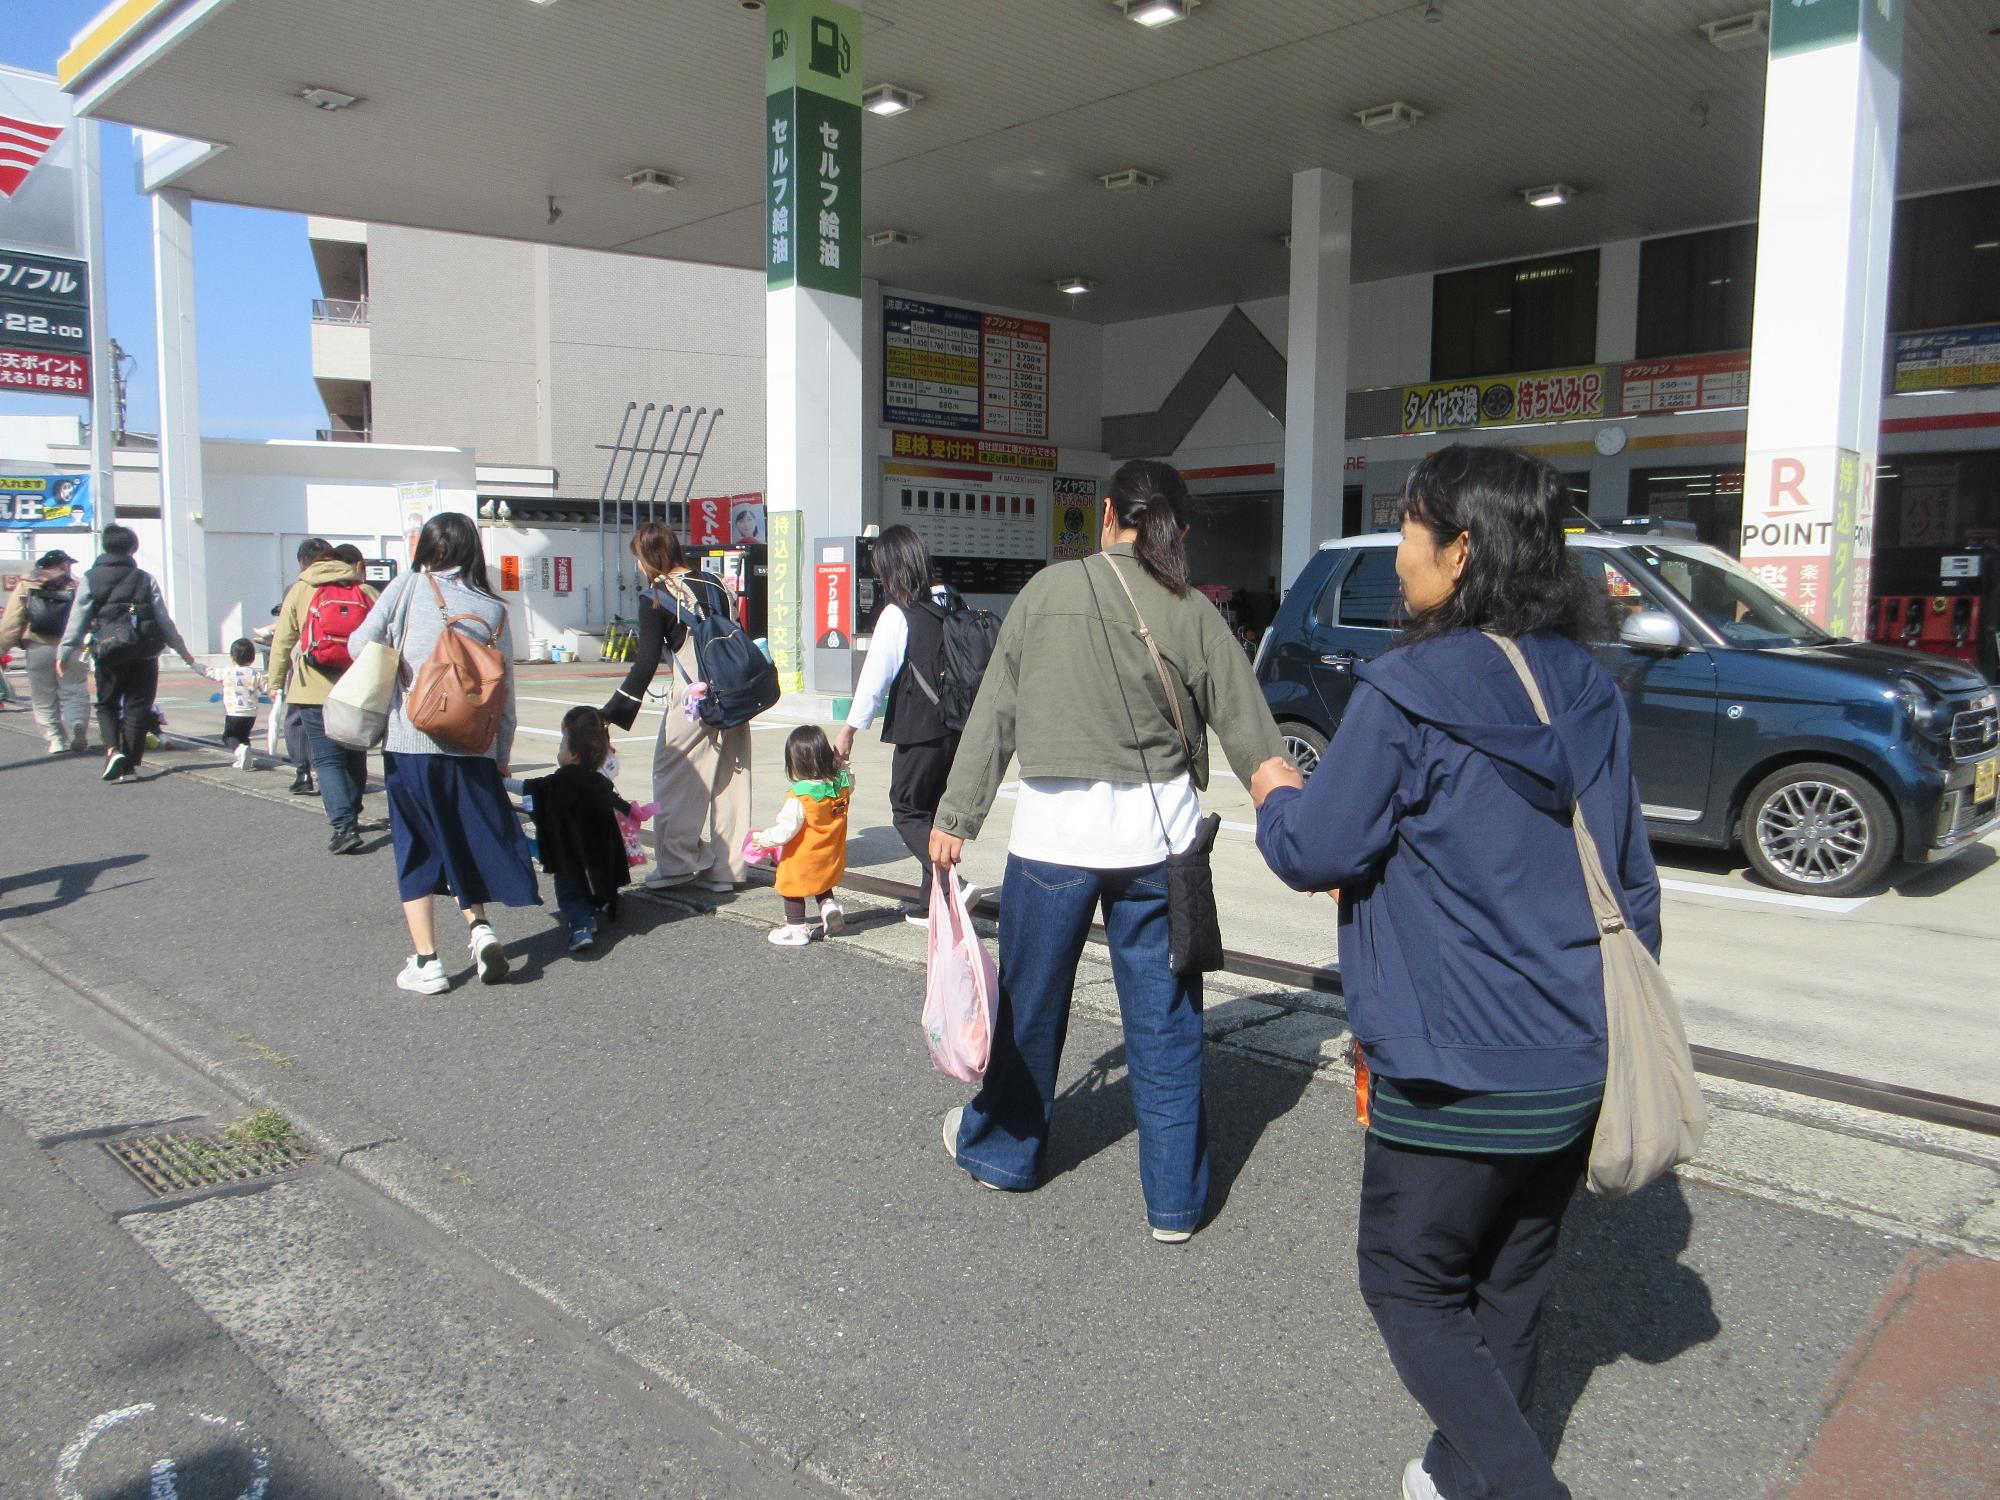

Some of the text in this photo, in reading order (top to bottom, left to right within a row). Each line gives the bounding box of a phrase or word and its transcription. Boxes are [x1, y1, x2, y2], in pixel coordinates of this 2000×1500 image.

[772, 118, 789, 264] セルフ給油
[819, 121, 840, 269] セルフ給油
[984, 316, 1020, 329] オプション
[0, 352, 82, 374] 天ポイント
[1624, 364, 1671, 377] オプション
[0, 371, 32, 384] える!
[1404, 385, 1479, 427] タイヤ交換
[1343, 456, 1365, 470] RE
[1053, 480, 1095, 496] タイヤ交換
[1769, 457, 1809, 507] R
[1741, 522, 1832, 546] POINT
[1829, 457, 1853, 638] 持込タイヤ
[558, 558, 569, 591] 火気厳禁
[774, 515, 790, 668] 持込タイヤ交換
